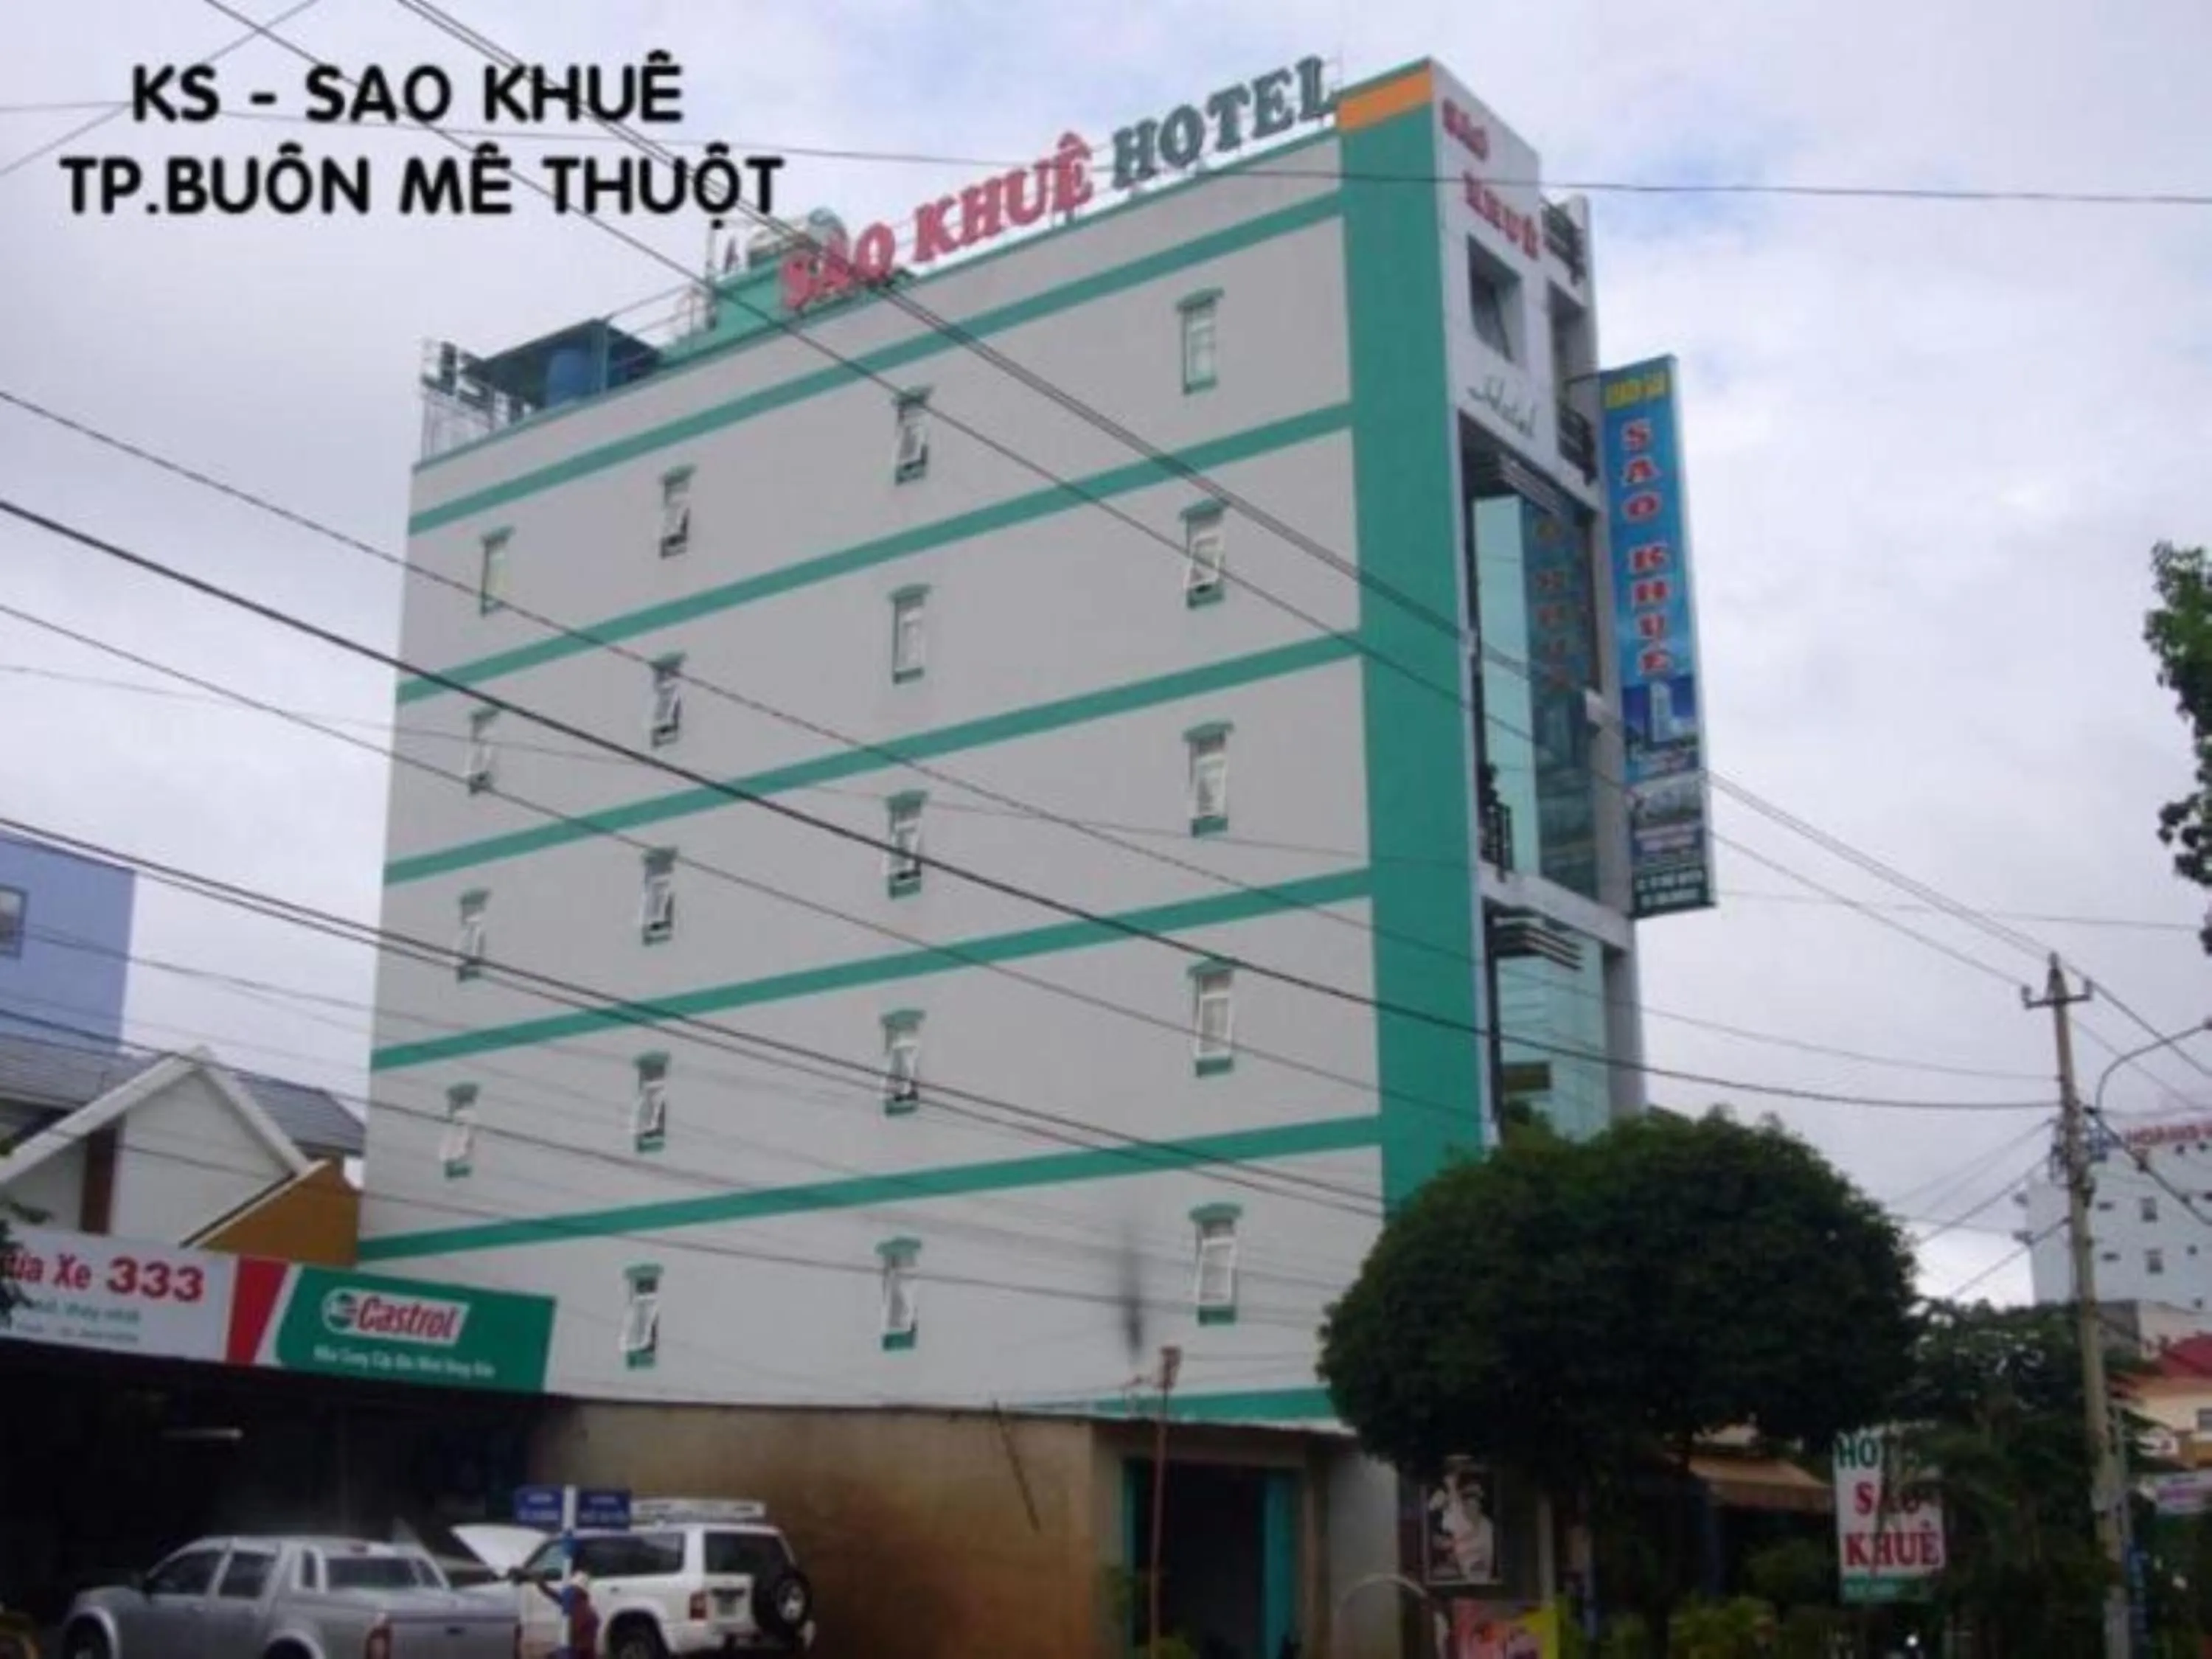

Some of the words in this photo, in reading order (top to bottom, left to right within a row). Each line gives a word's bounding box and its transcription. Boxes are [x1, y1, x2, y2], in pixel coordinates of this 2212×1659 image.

[780, 221, 895, 310] SAO
[913, 131, 1093, 261] KHUÊ
[1112, 55, 1336, 189] HOTEL
[54, 1253, 92, 1290] Xe
[107, 1256, 204, 1302] 333
[358, 1295, 461, 1339] Castrol
